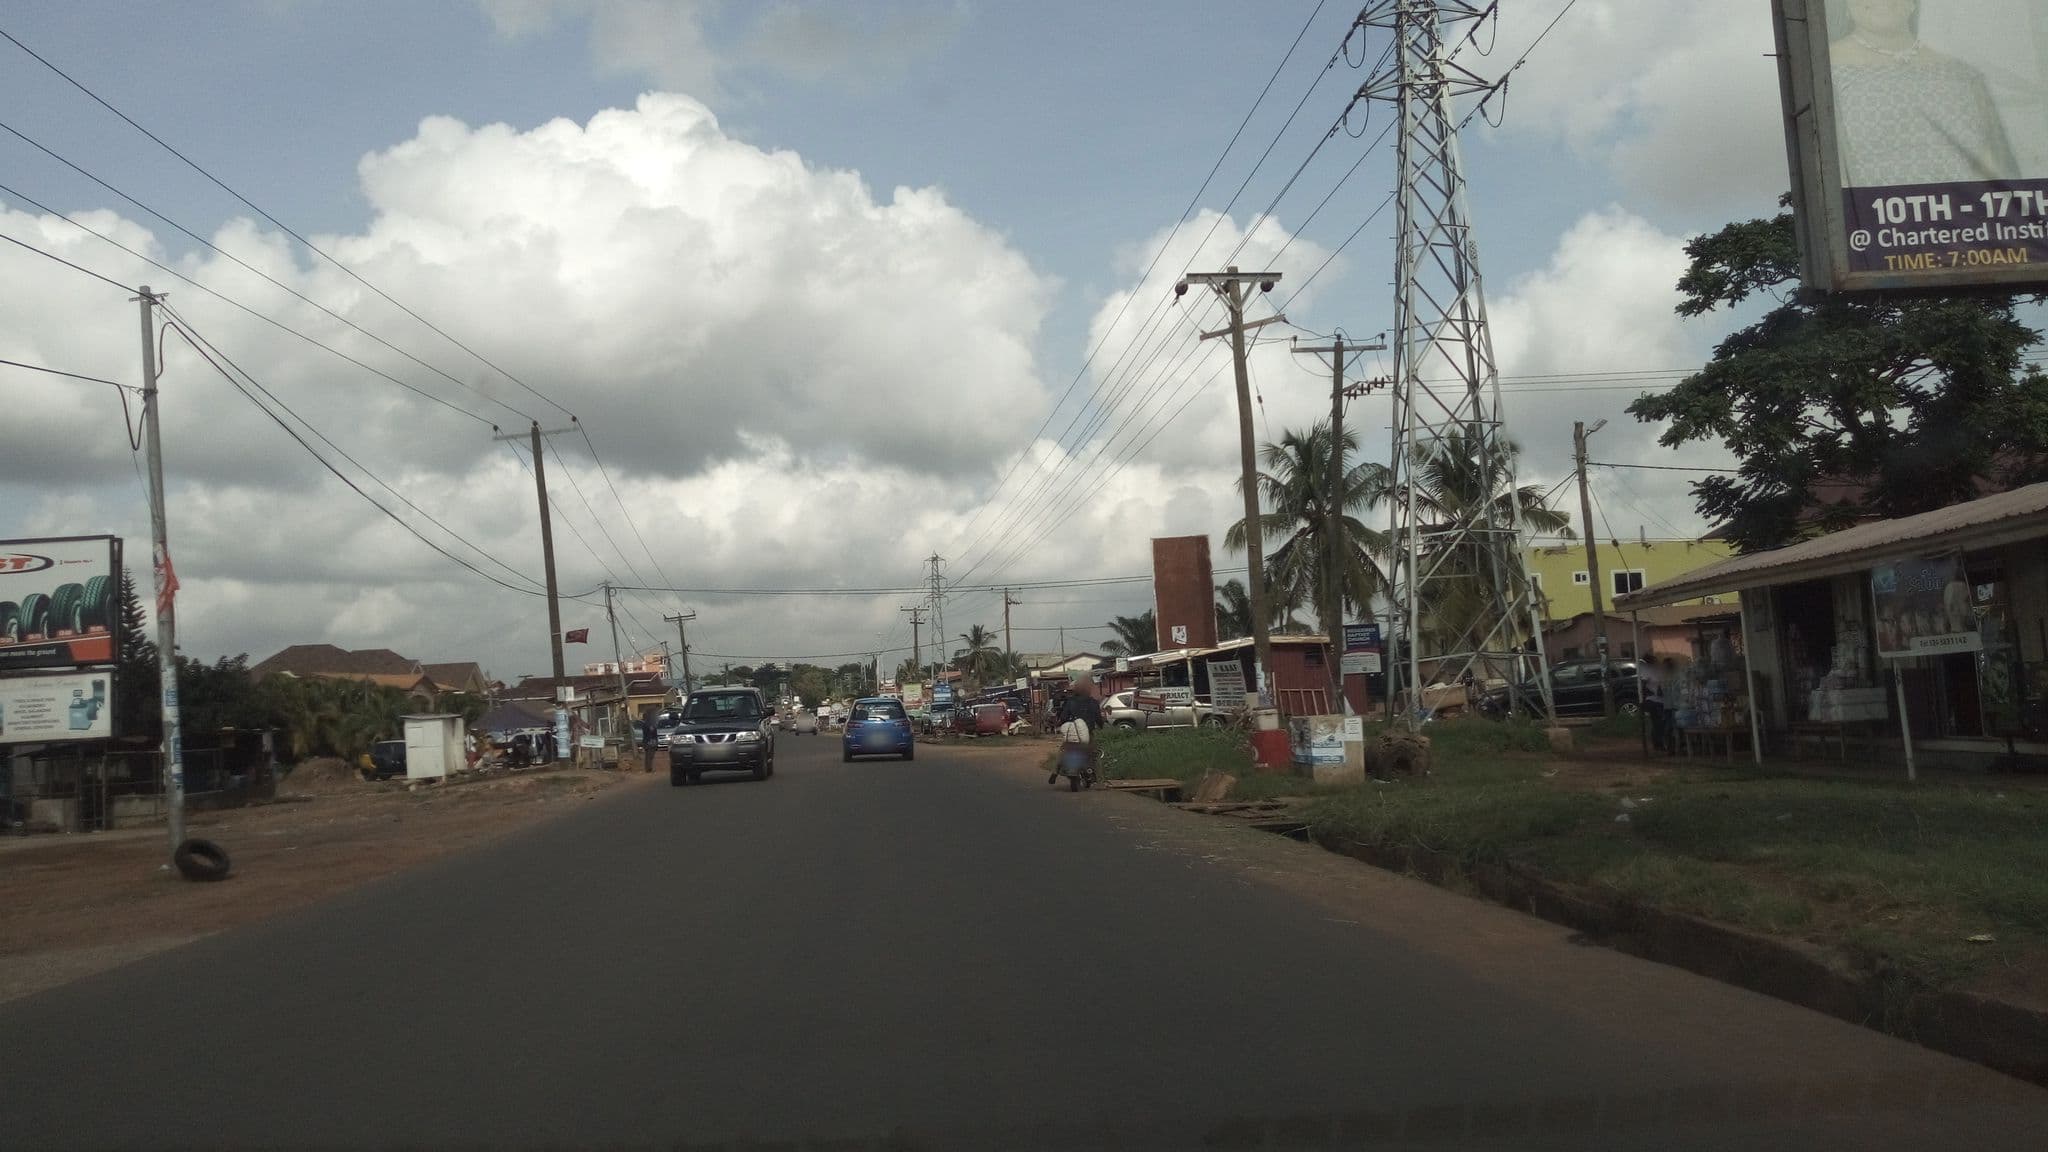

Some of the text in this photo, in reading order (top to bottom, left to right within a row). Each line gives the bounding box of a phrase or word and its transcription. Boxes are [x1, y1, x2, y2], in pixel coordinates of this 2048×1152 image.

[1872, 194, 1952, 224] 10TH
[1960, 204, 1973, 213] -
[1850, 219, 2048, 252] @ Chartered Insti
[1884, 247, 2029, 271] TIME: 7:00AM
